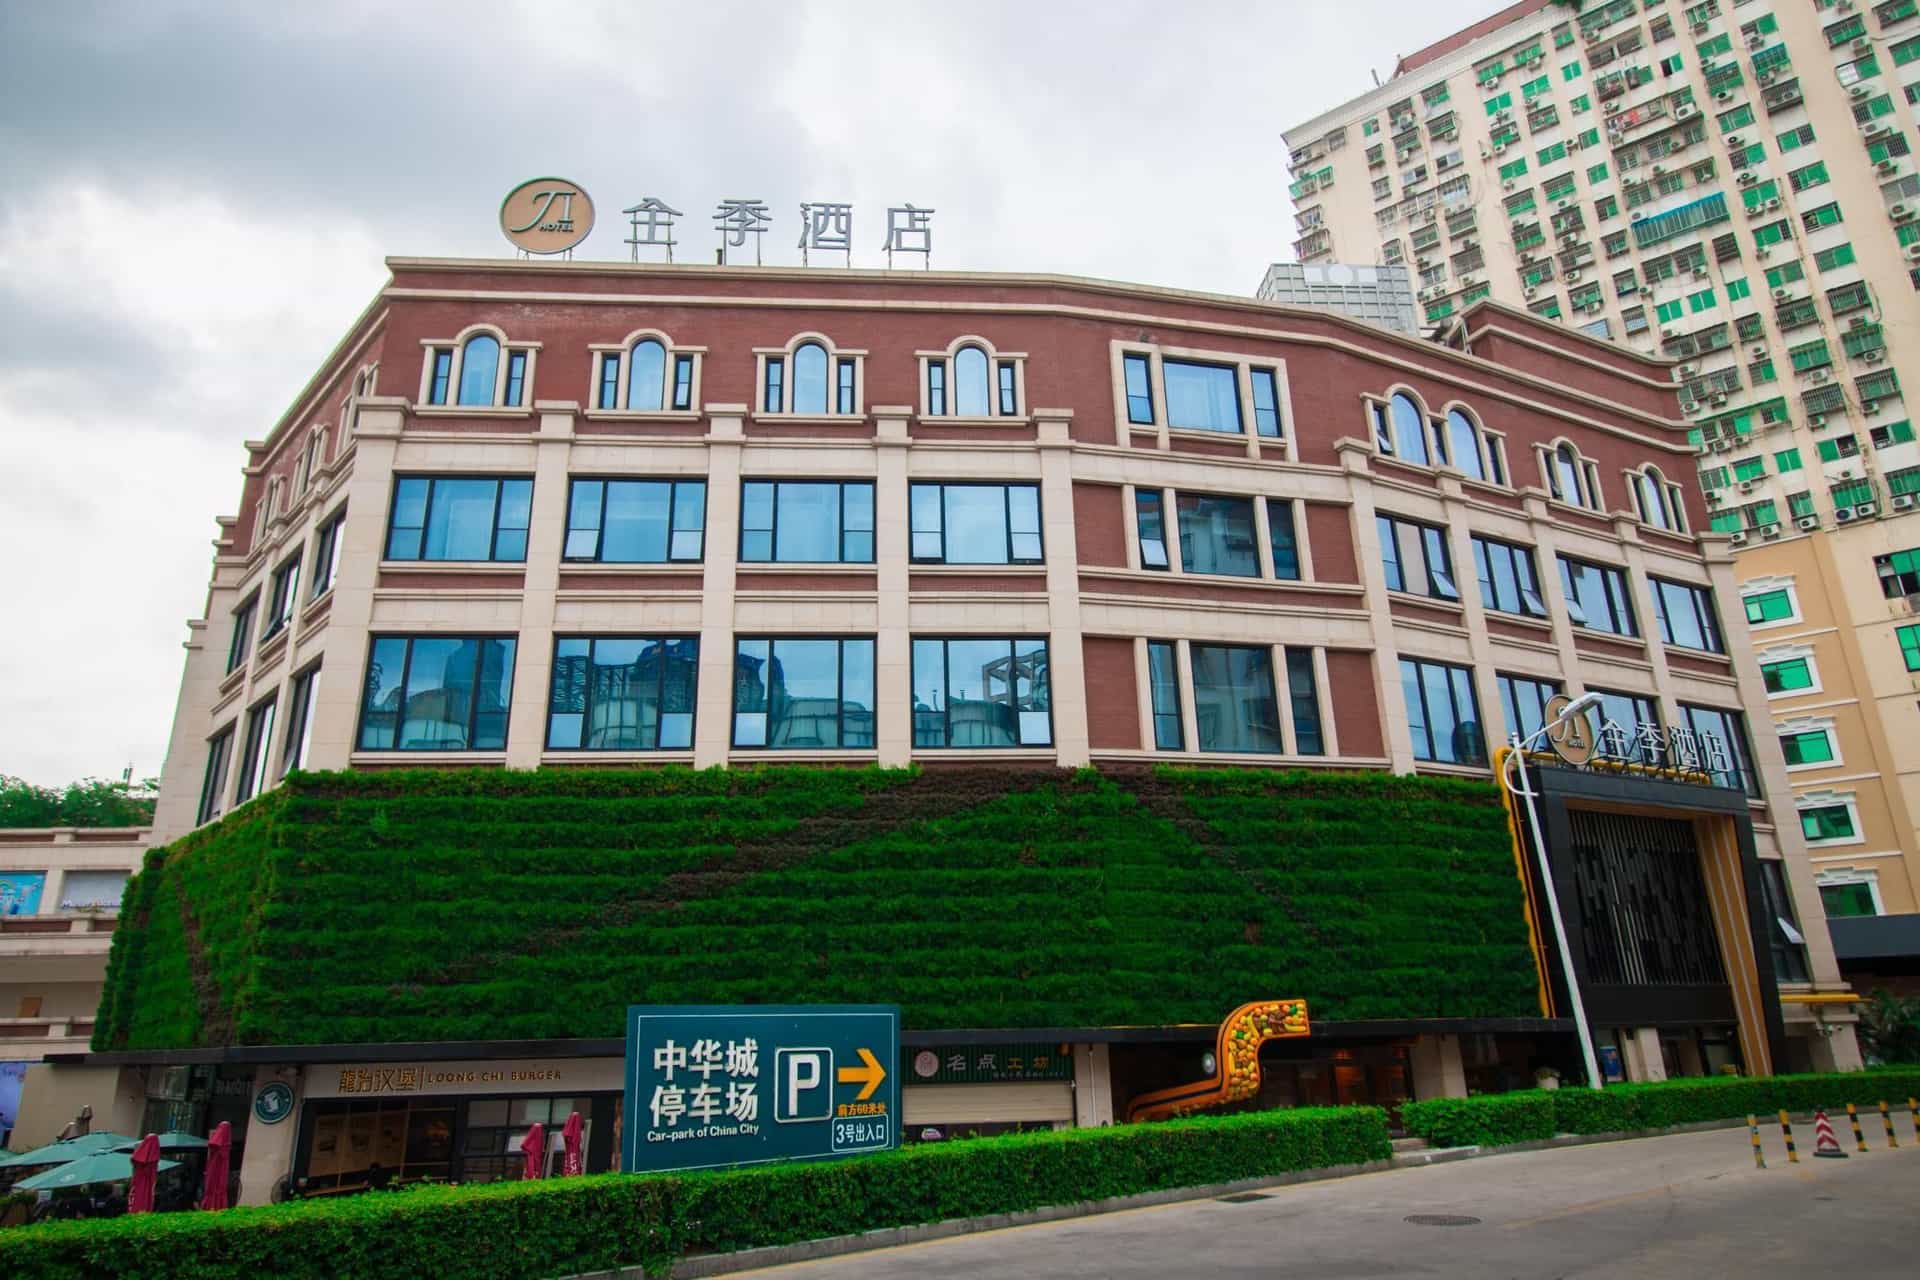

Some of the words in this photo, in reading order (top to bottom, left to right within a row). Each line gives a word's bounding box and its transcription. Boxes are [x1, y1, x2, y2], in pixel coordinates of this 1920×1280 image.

[539, 222, 574, 233] HOTEL
[622, 197, 935, 252] 全季酒店
[1601, 718, 1730, 773] 全季酒店
[428, 1071, 475, 1083] LOONG
[481, 1071, 504, 1081] CHI
[511, 1070, 561, 1081] BURGER
[653, 1038, 759, 1081] 中华城
[649, 1082, 759, 1127] 停车场
[788, 1054, 820, 1116] P
[647, 1128, 695, 1142] Car-park
[697, 1126, 708, 1138] of
[710, 1125, 737, 1136] China
[740, 1123, 759, 1135] City
[836, 1122, 884, 1144] 3号出入口
